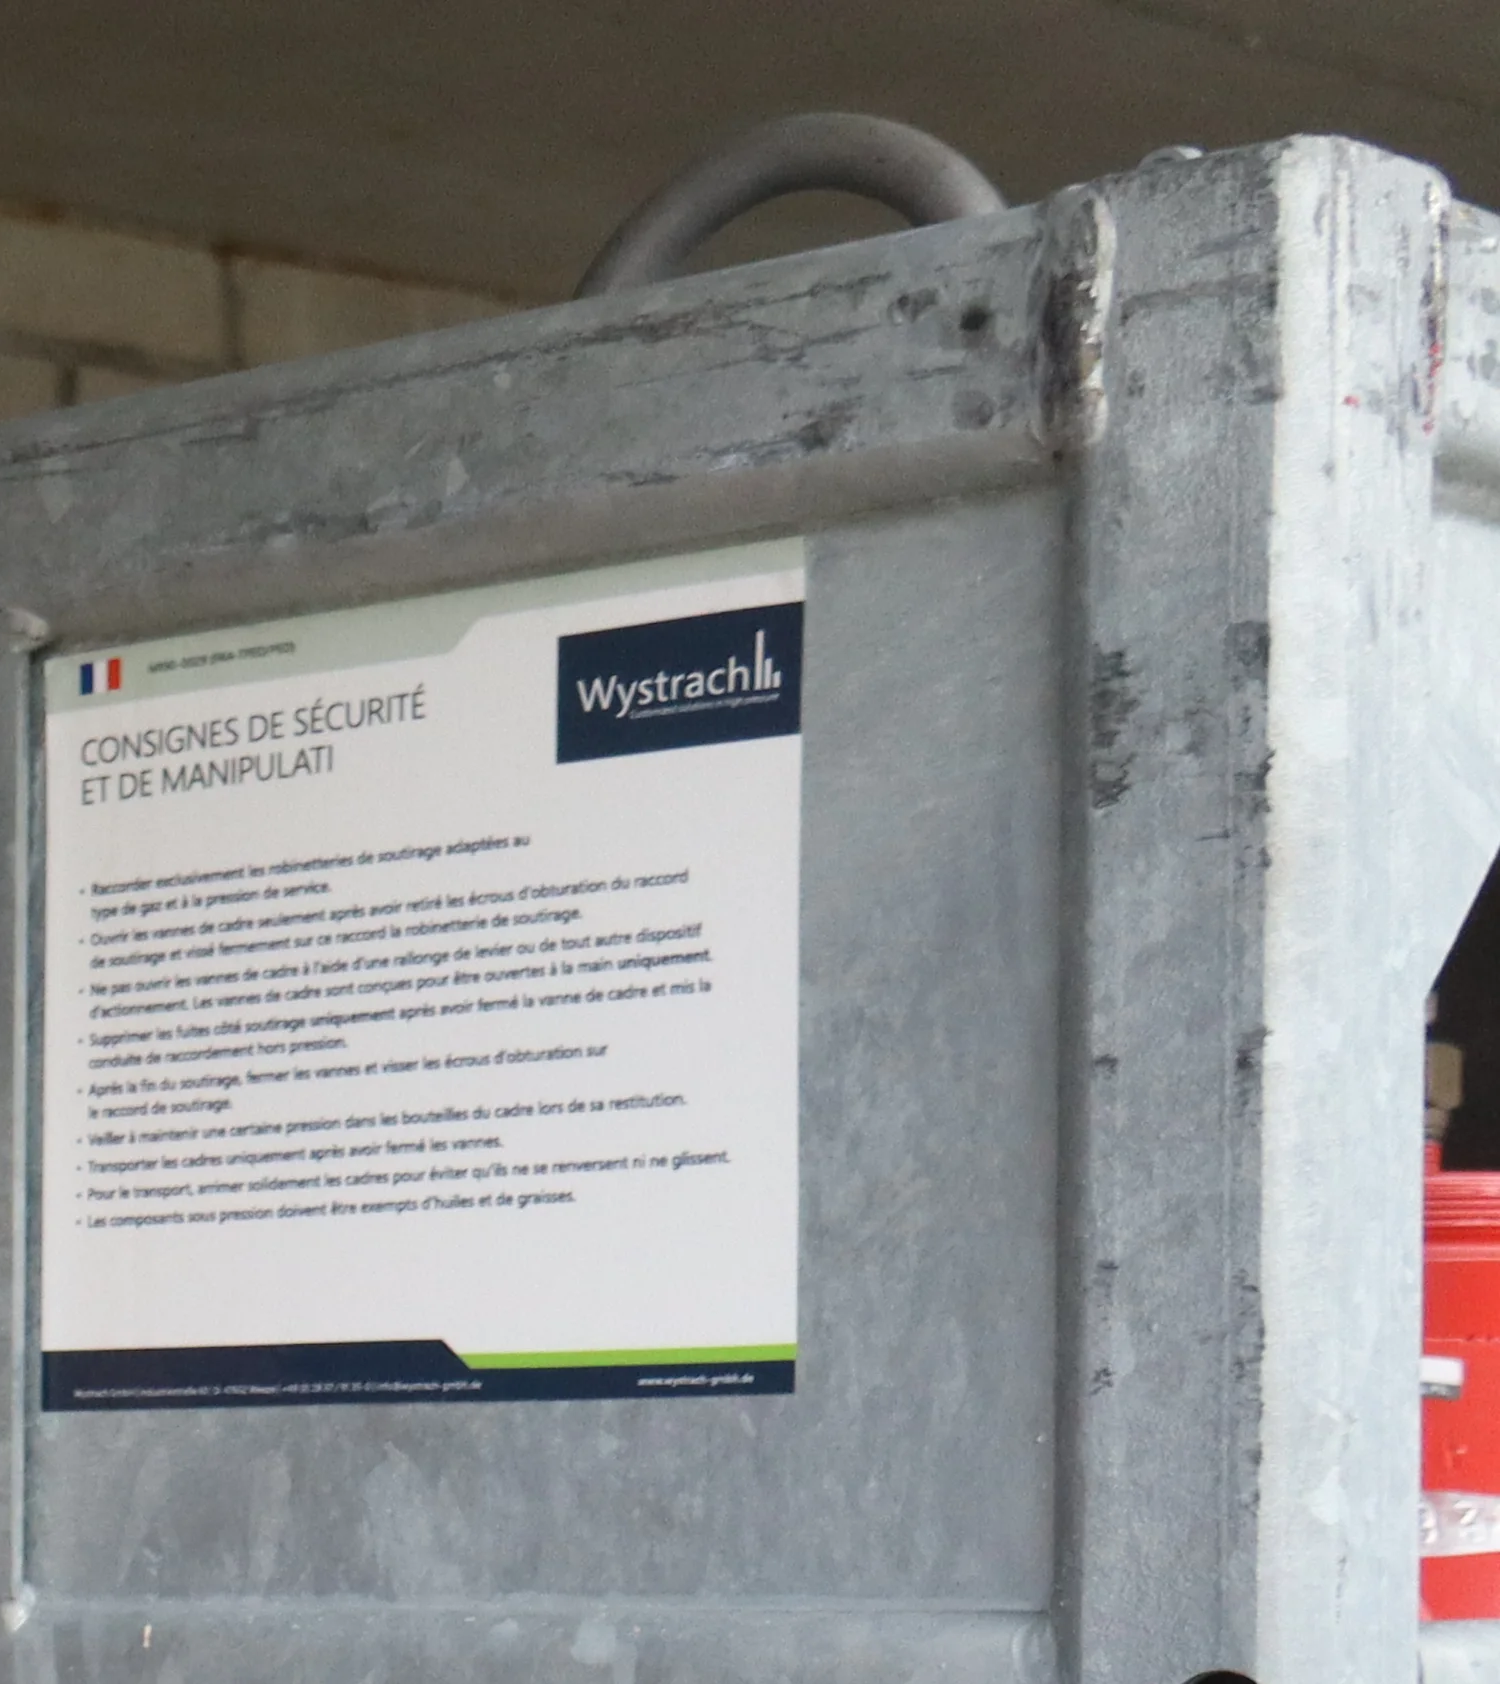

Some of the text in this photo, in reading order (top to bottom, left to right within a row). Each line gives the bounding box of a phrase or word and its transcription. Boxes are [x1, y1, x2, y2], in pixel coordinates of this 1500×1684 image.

[575, 653, 753, 721] Wystrach
[79, 682, 427, 768] CONSIGNES DE SÉCURITÉ
[79, 741, 335, 807] ET DE MANIPULATI
